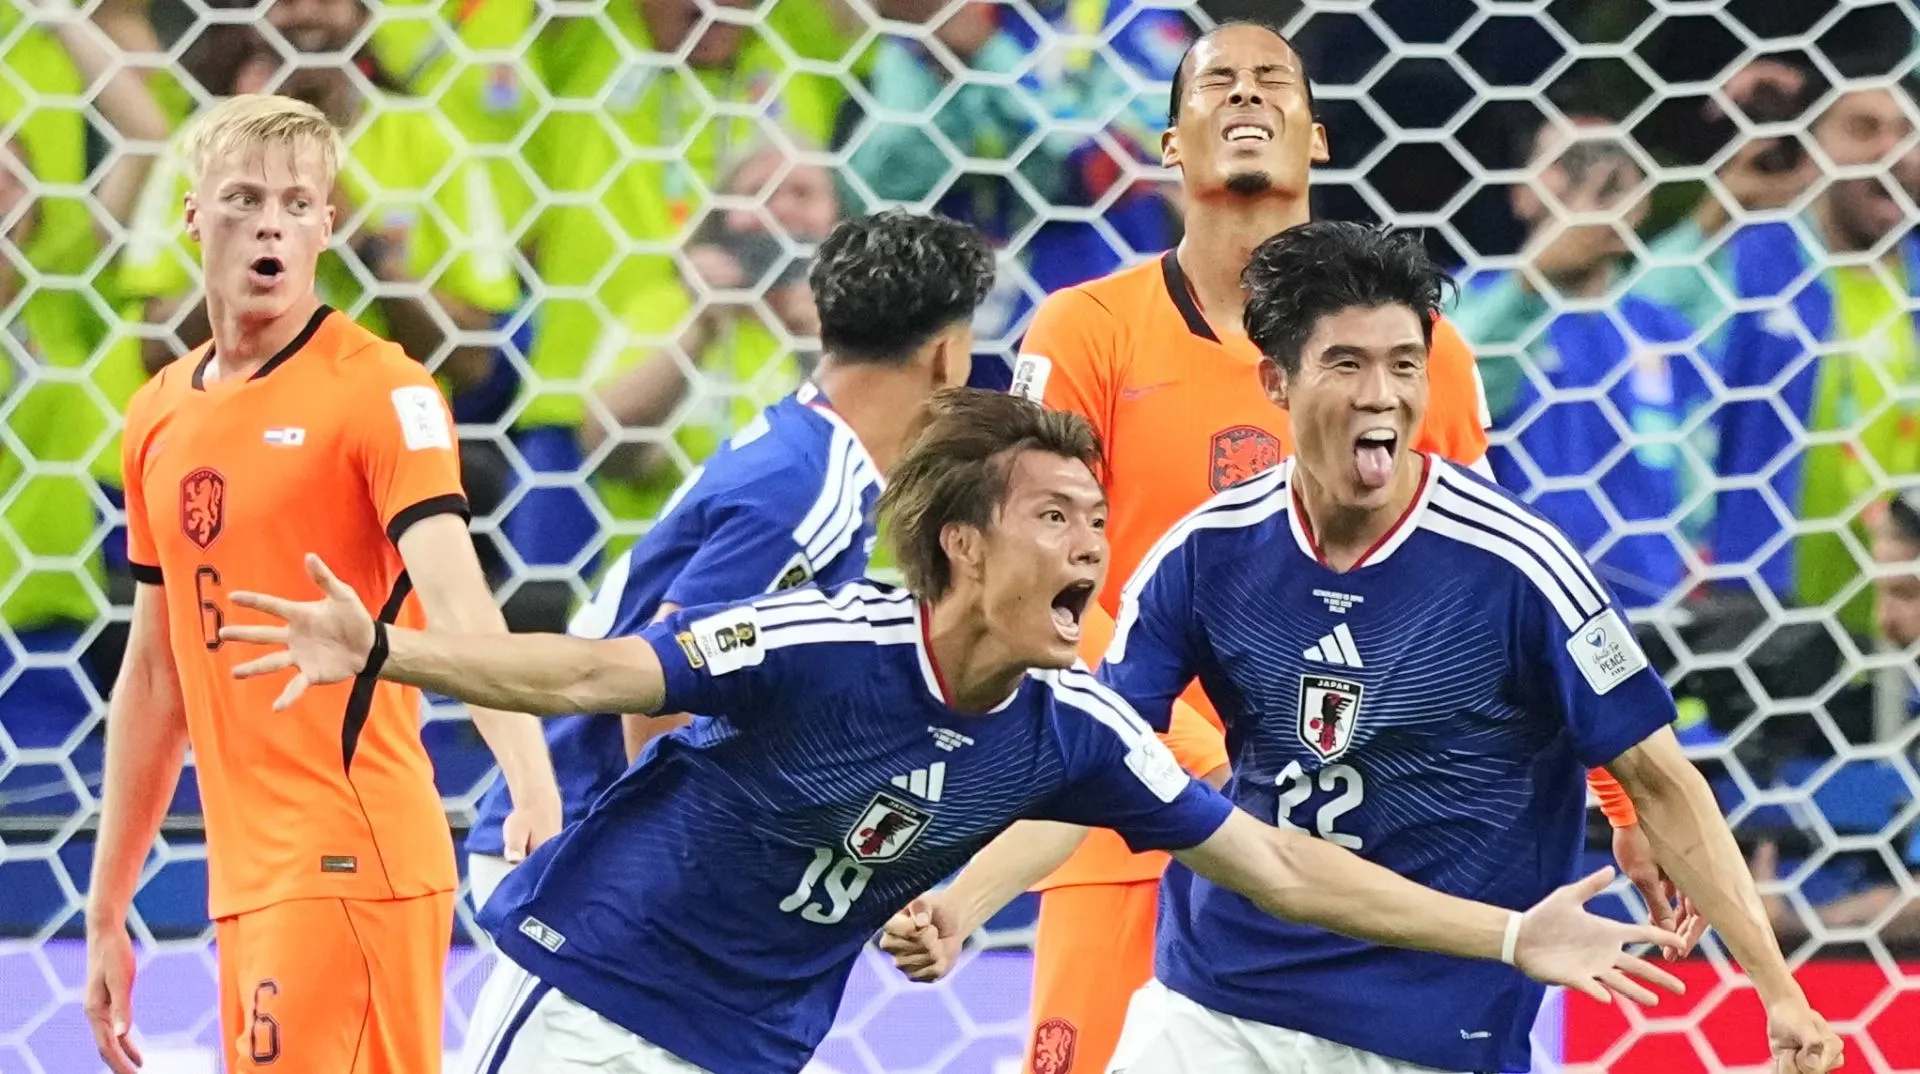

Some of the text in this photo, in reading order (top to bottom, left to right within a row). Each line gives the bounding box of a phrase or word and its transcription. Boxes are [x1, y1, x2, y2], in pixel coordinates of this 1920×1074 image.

[195, 564, 224, 652] 6
[1317, 680, 1350, 691] JAPAN
[1600, 651, 1627, 673] PEACE
[1275, 760, 1364, 849] 22
[779, 847, 874, 924] 19
[249, 977, 280, 1067] 6
